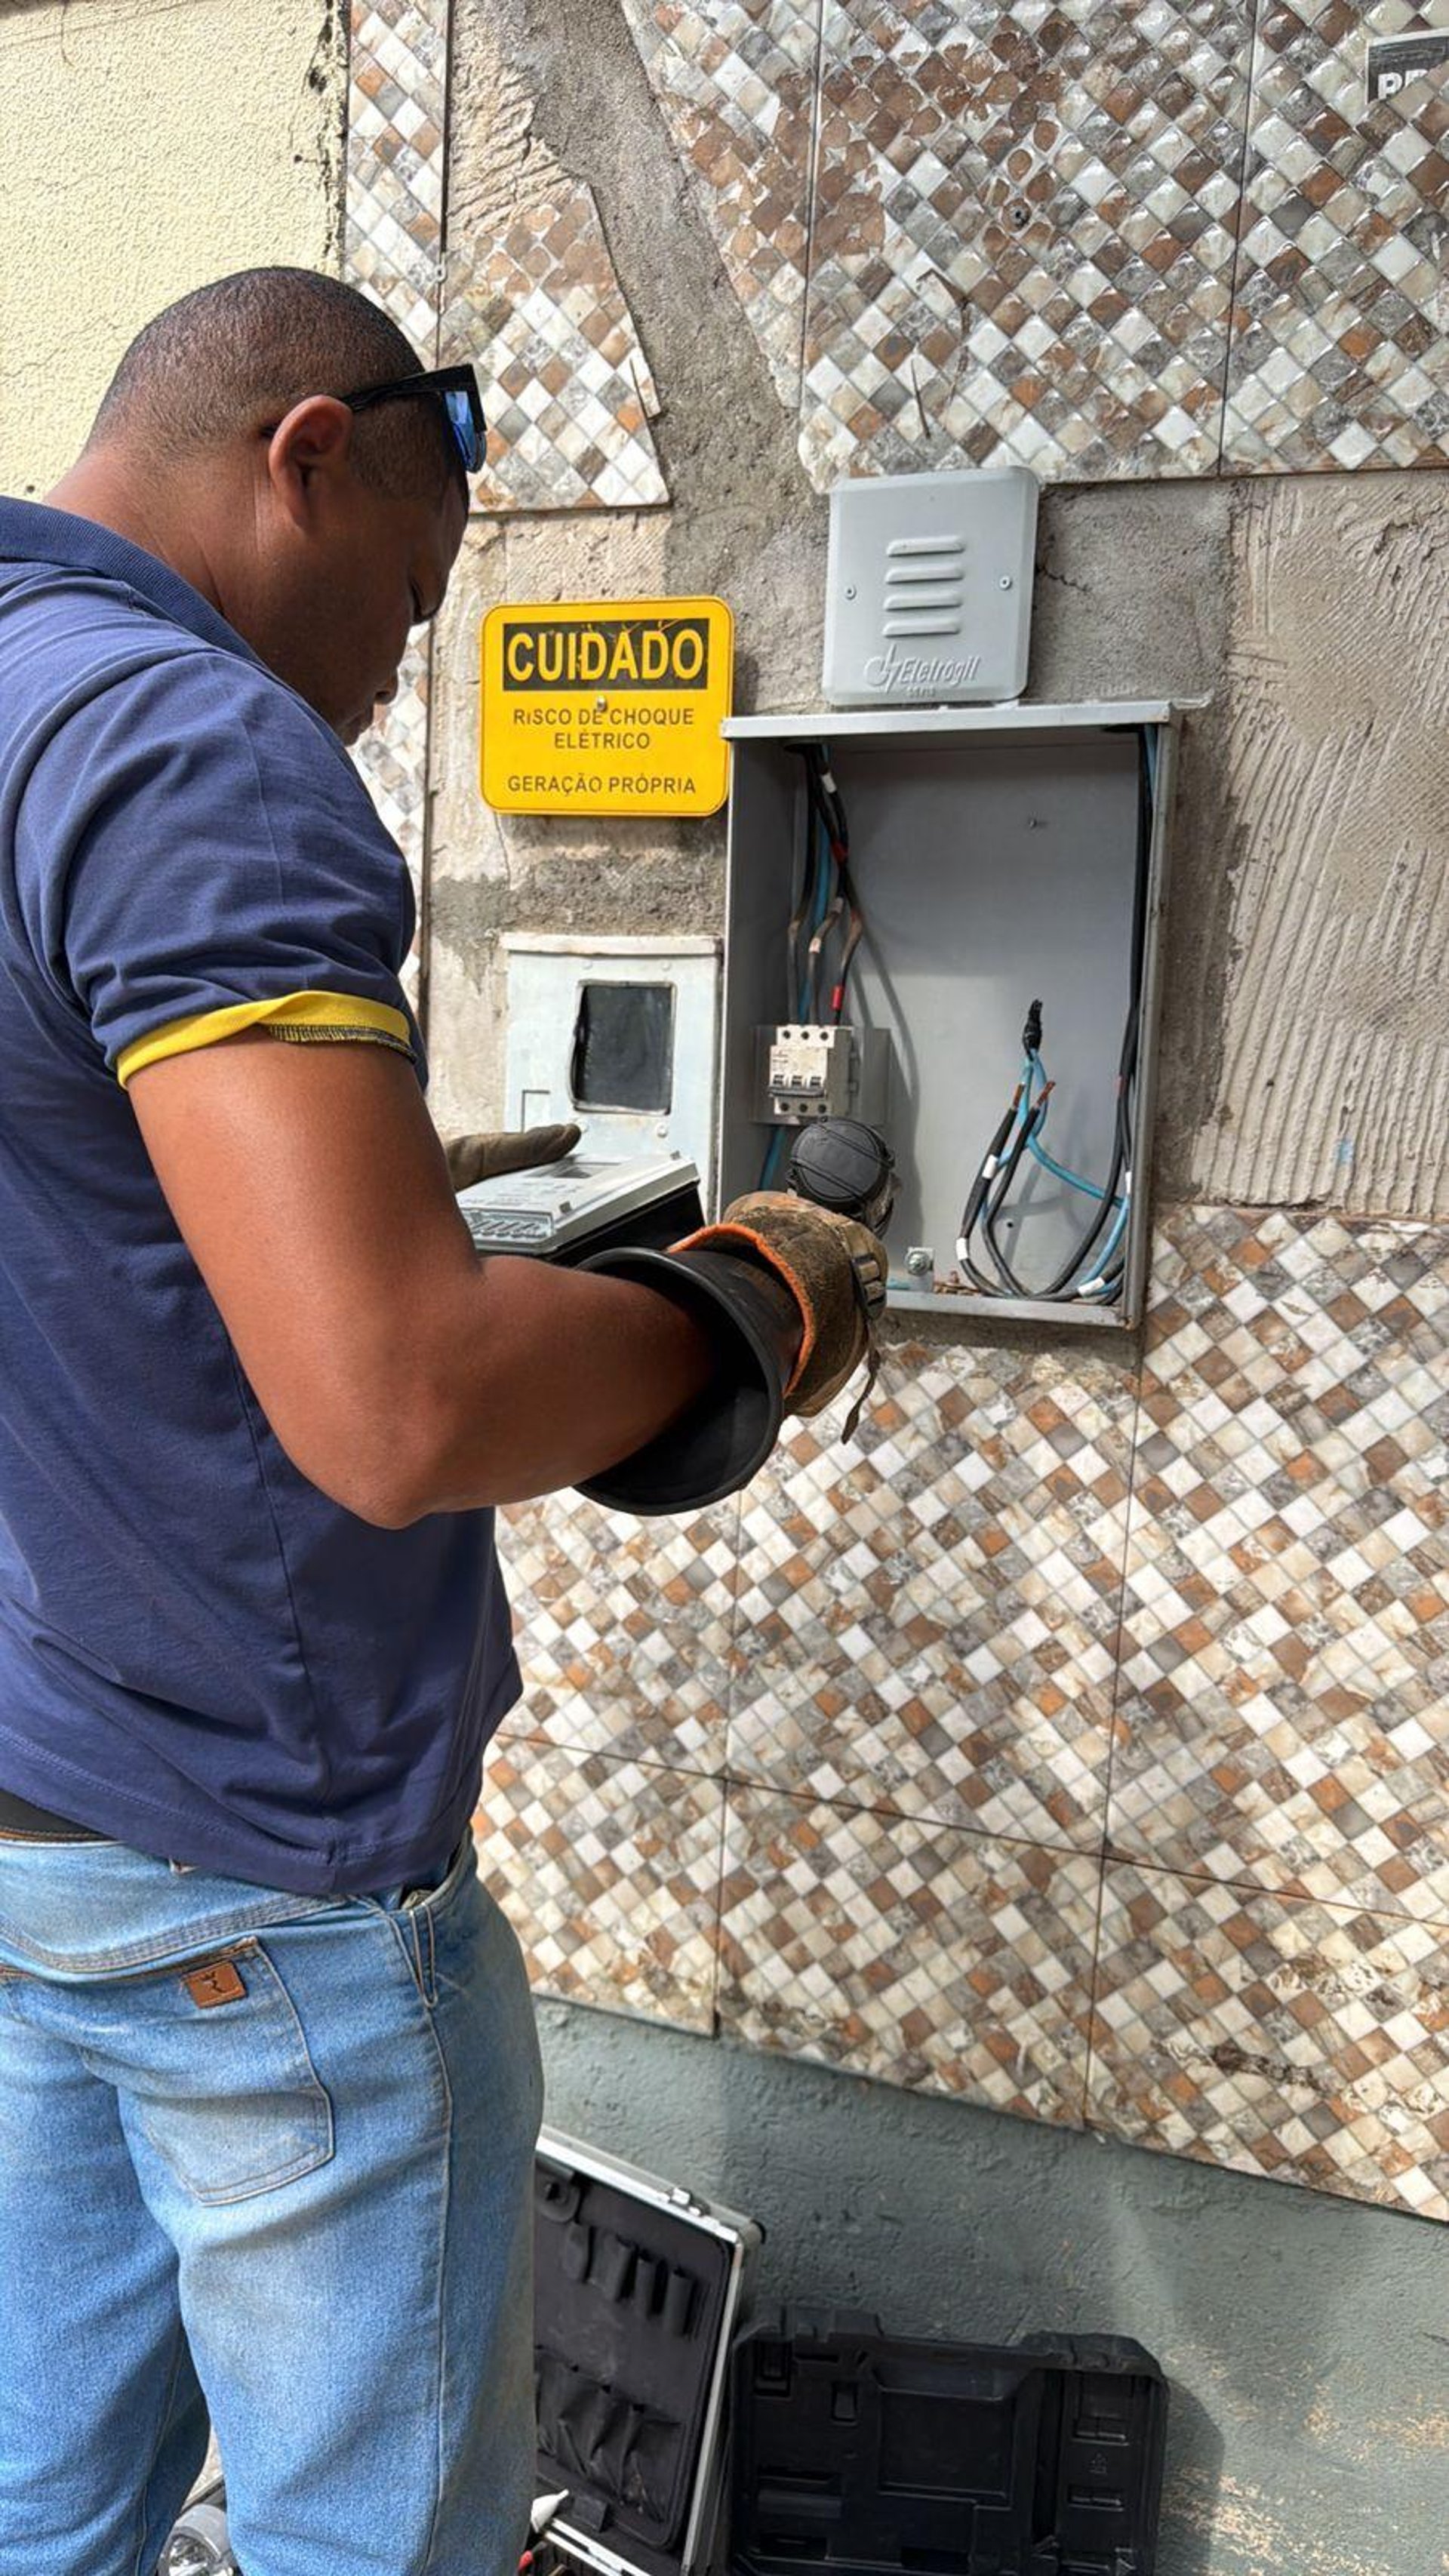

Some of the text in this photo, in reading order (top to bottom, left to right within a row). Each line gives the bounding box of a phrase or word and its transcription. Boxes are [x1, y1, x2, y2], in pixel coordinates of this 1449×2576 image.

[507, 629, 704, 682] CUIDADO
[513, 708, 694, 726] RISCO DE CHOQUE
[555, 730, 651, 749] ELÉTRICO
[508, 773, 696, 796] GERAÇÃO PRÓPRIA
